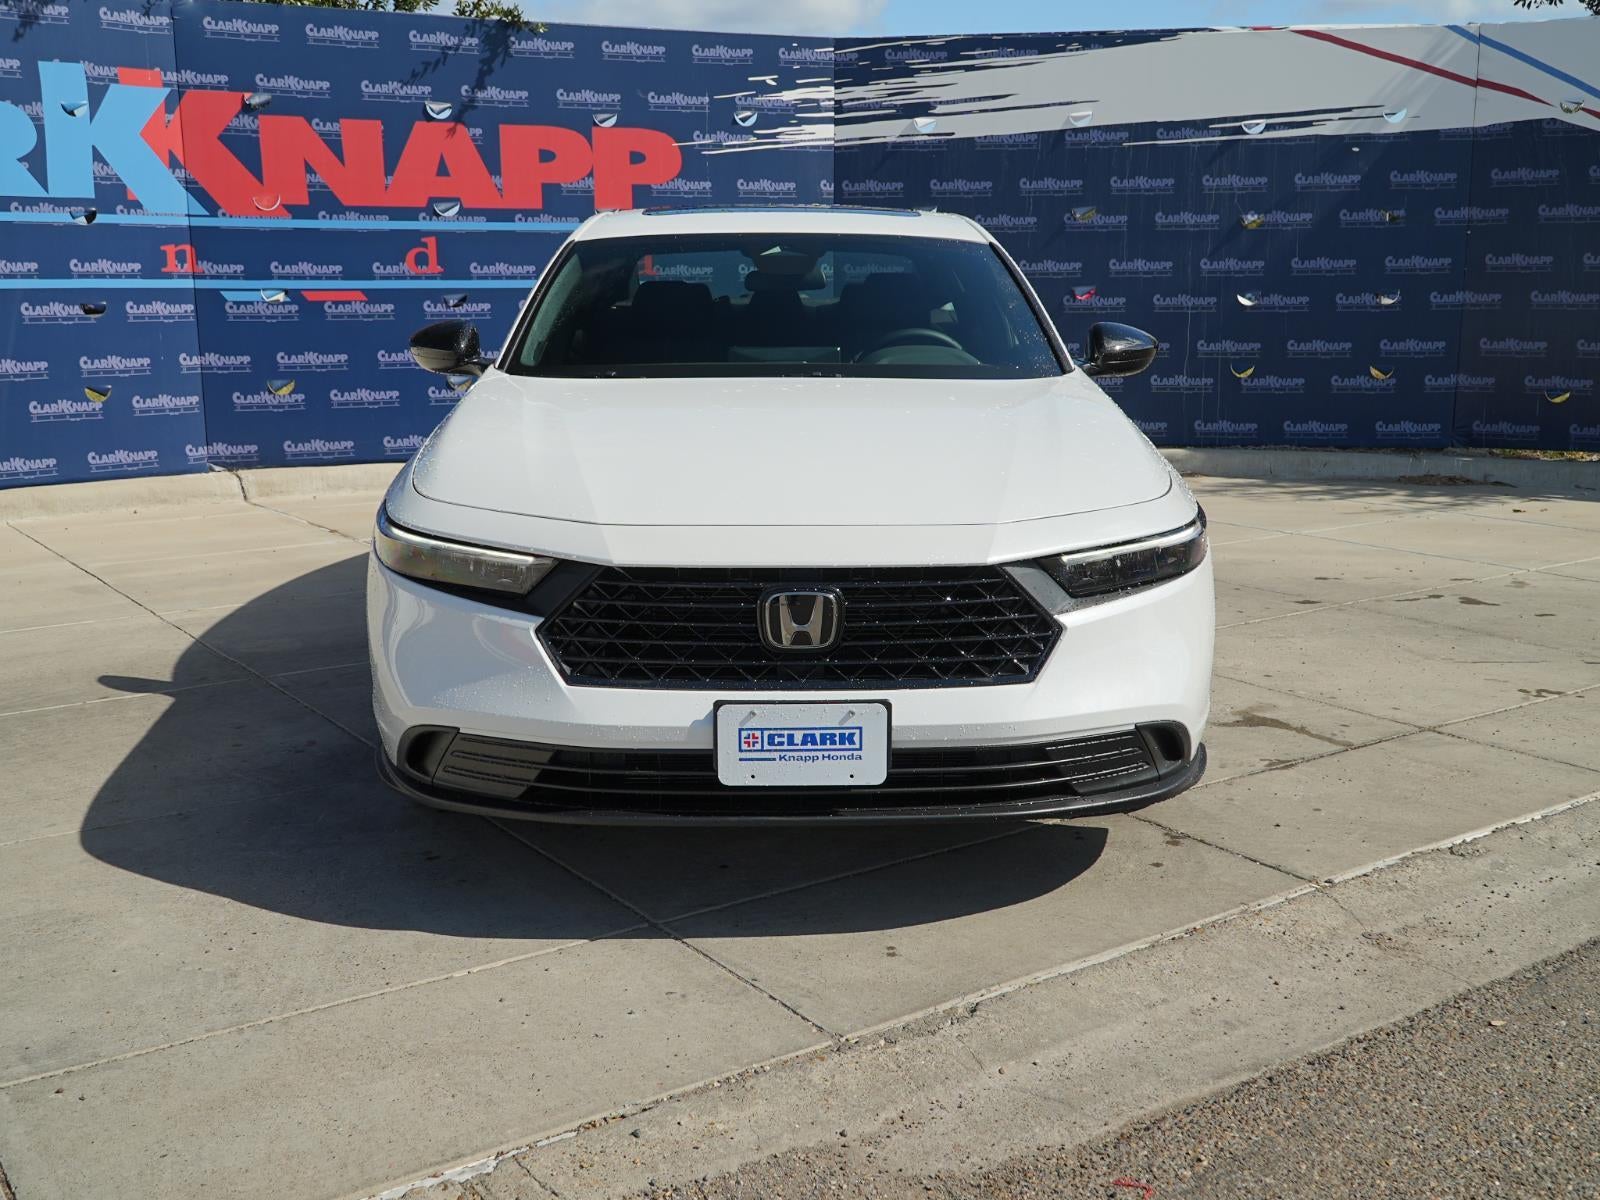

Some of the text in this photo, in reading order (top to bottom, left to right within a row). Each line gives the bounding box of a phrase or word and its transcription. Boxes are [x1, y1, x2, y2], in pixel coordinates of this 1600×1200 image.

[767, 732, 856, 747] CLARK
[778, 753, 863, 763] Knapp Honda
